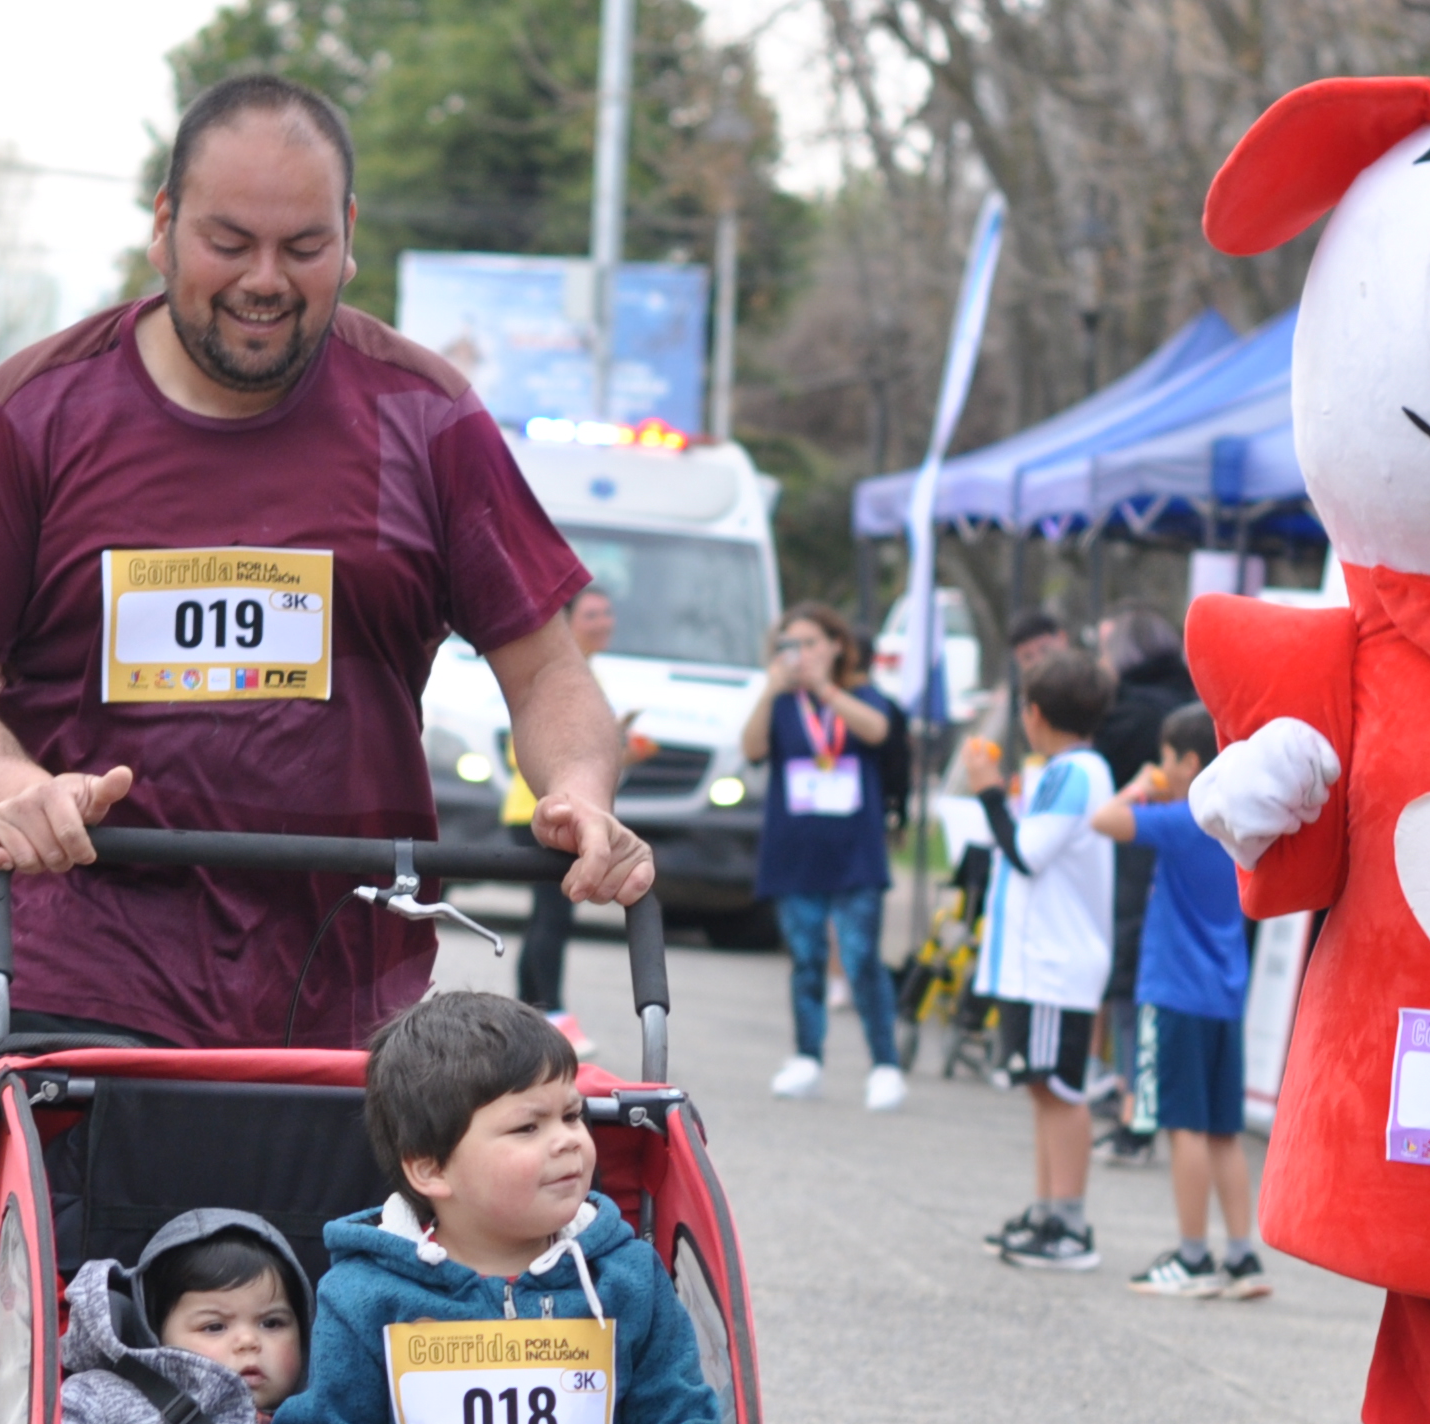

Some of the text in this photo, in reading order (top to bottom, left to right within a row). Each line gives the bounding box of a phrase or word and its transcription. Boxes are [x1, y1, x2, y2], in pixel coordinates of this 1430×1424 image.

[128, 556, 233, 586] Corrida
[237, 561, 262, 571] POR
[264, 562, 279, 573] LA
[237, 571, 301, 585] INCLUSIÓN
[282, 593, 308, 610] 3K
[174, 598, 265, 649] 019
[408, 1332, 569, 1365] Corrida POR LA
[525, 1347, 590, 1361] INCLUSIÓN
[573, 1371, 596, 1389] 3K
